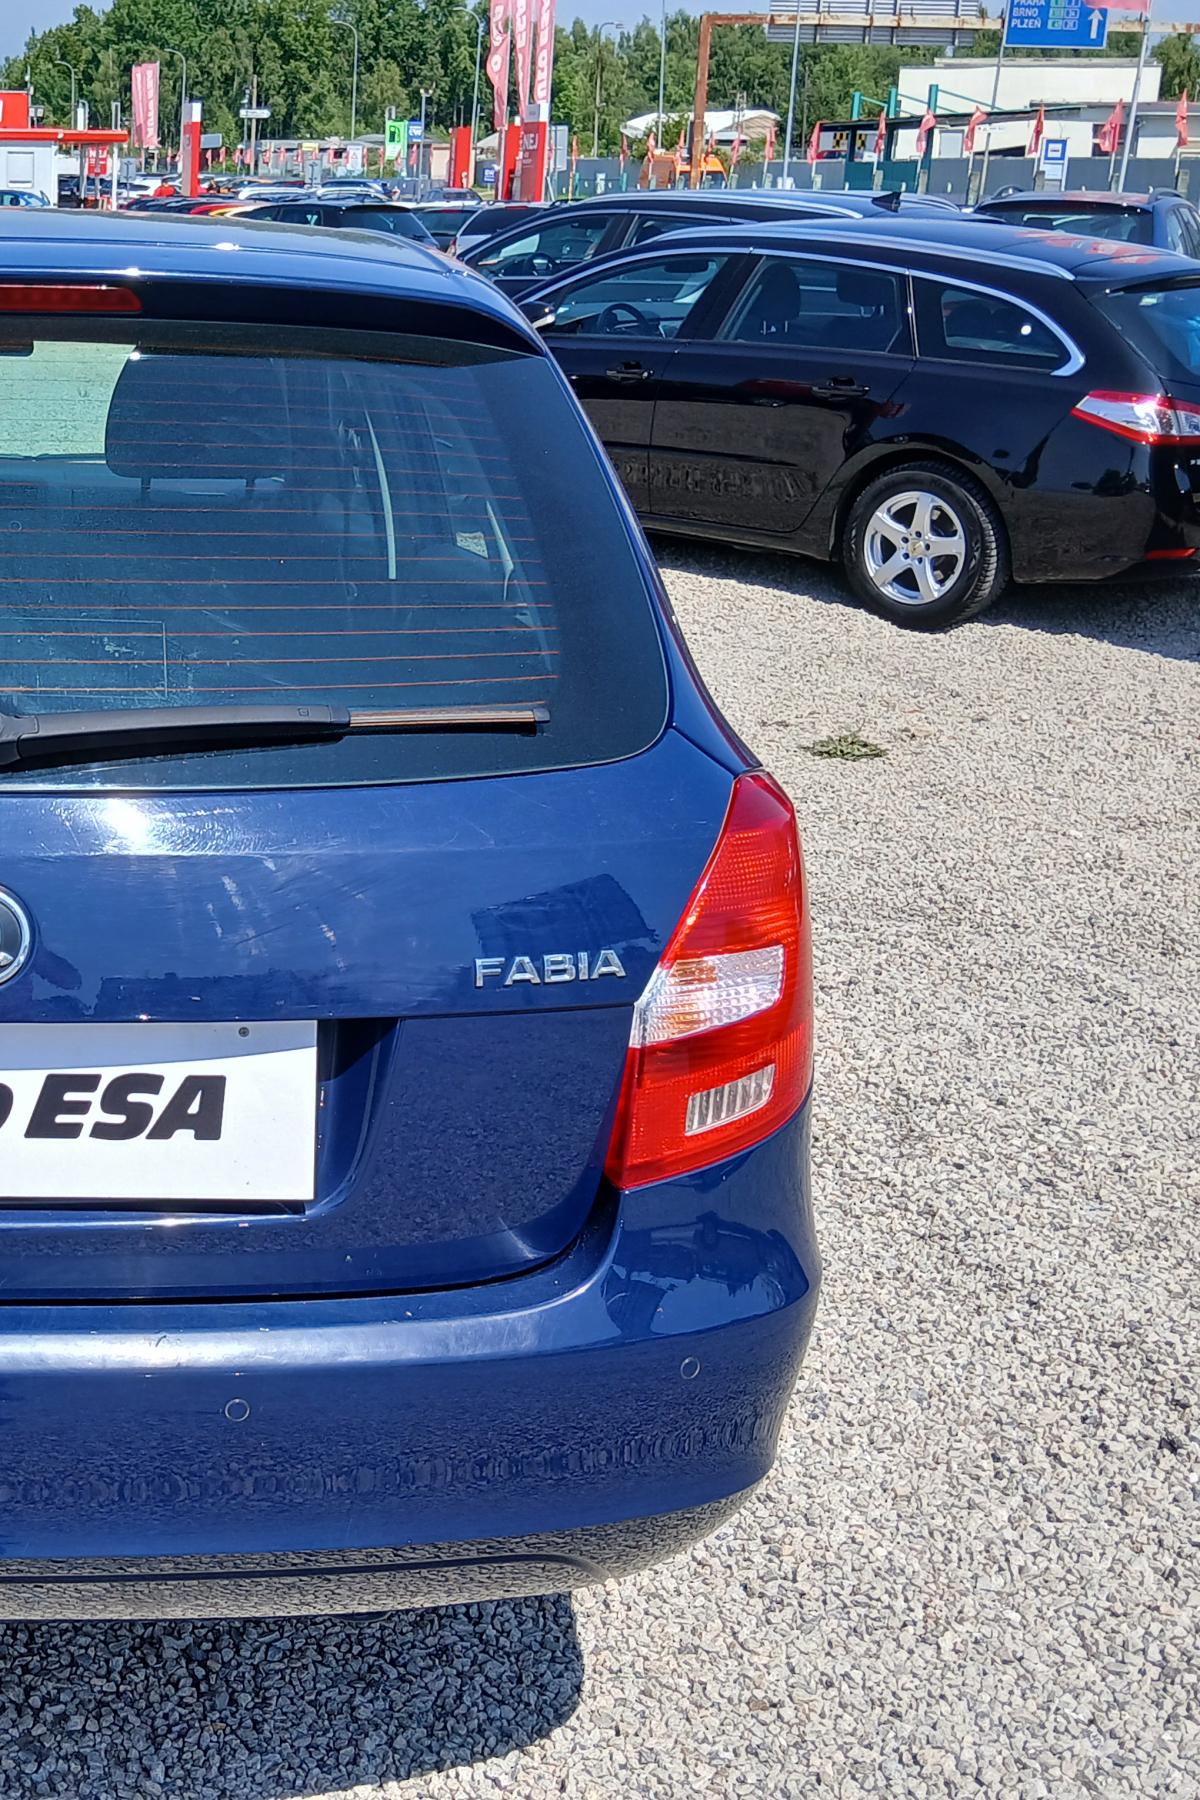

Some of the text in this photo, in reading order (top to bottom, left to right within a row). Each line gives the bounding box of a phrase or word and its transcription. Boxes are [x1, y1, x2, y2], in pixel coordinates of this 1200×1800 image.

[1010, 18, 1041, 29] PLZEŇ
[1012, 8, 1039, 17] BRNO
[474, 949, 627, 988] FABIA
[23, 1072, 228, 1142] ESA
